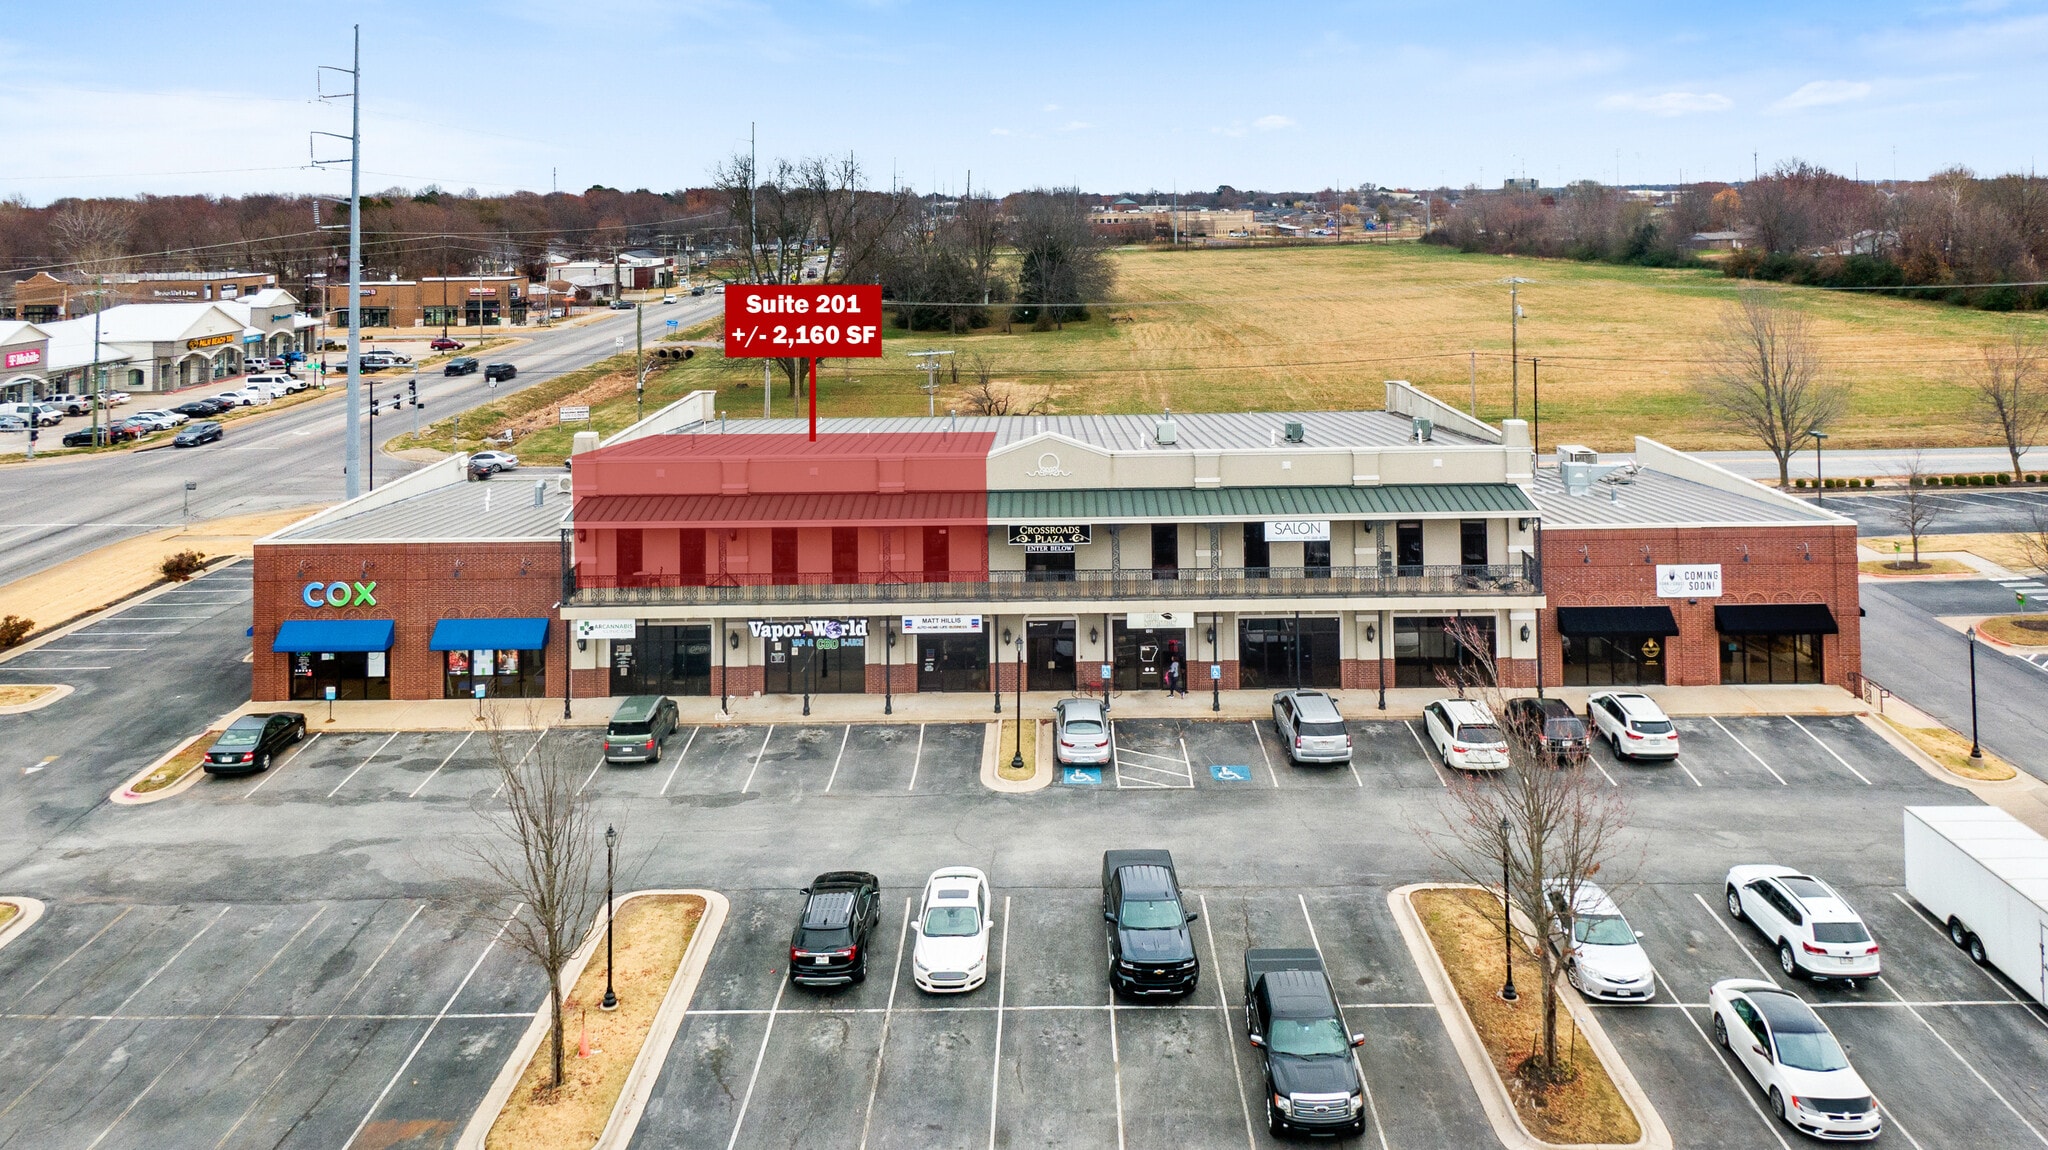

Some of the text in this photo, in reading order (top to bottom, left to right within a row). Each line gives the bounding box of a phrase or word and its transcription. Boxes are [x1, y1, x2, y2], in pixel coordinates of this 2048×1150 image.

[1274, 522, 1321, 535] SALON
[1684, 571, 1718, 580] COMING
[1688, 581, 1715, 591] SOON!
[303, 581, 377, 608] COX
[748, 619, 868, 641] Vapor World
[816, 638, 839, 650] CBD
